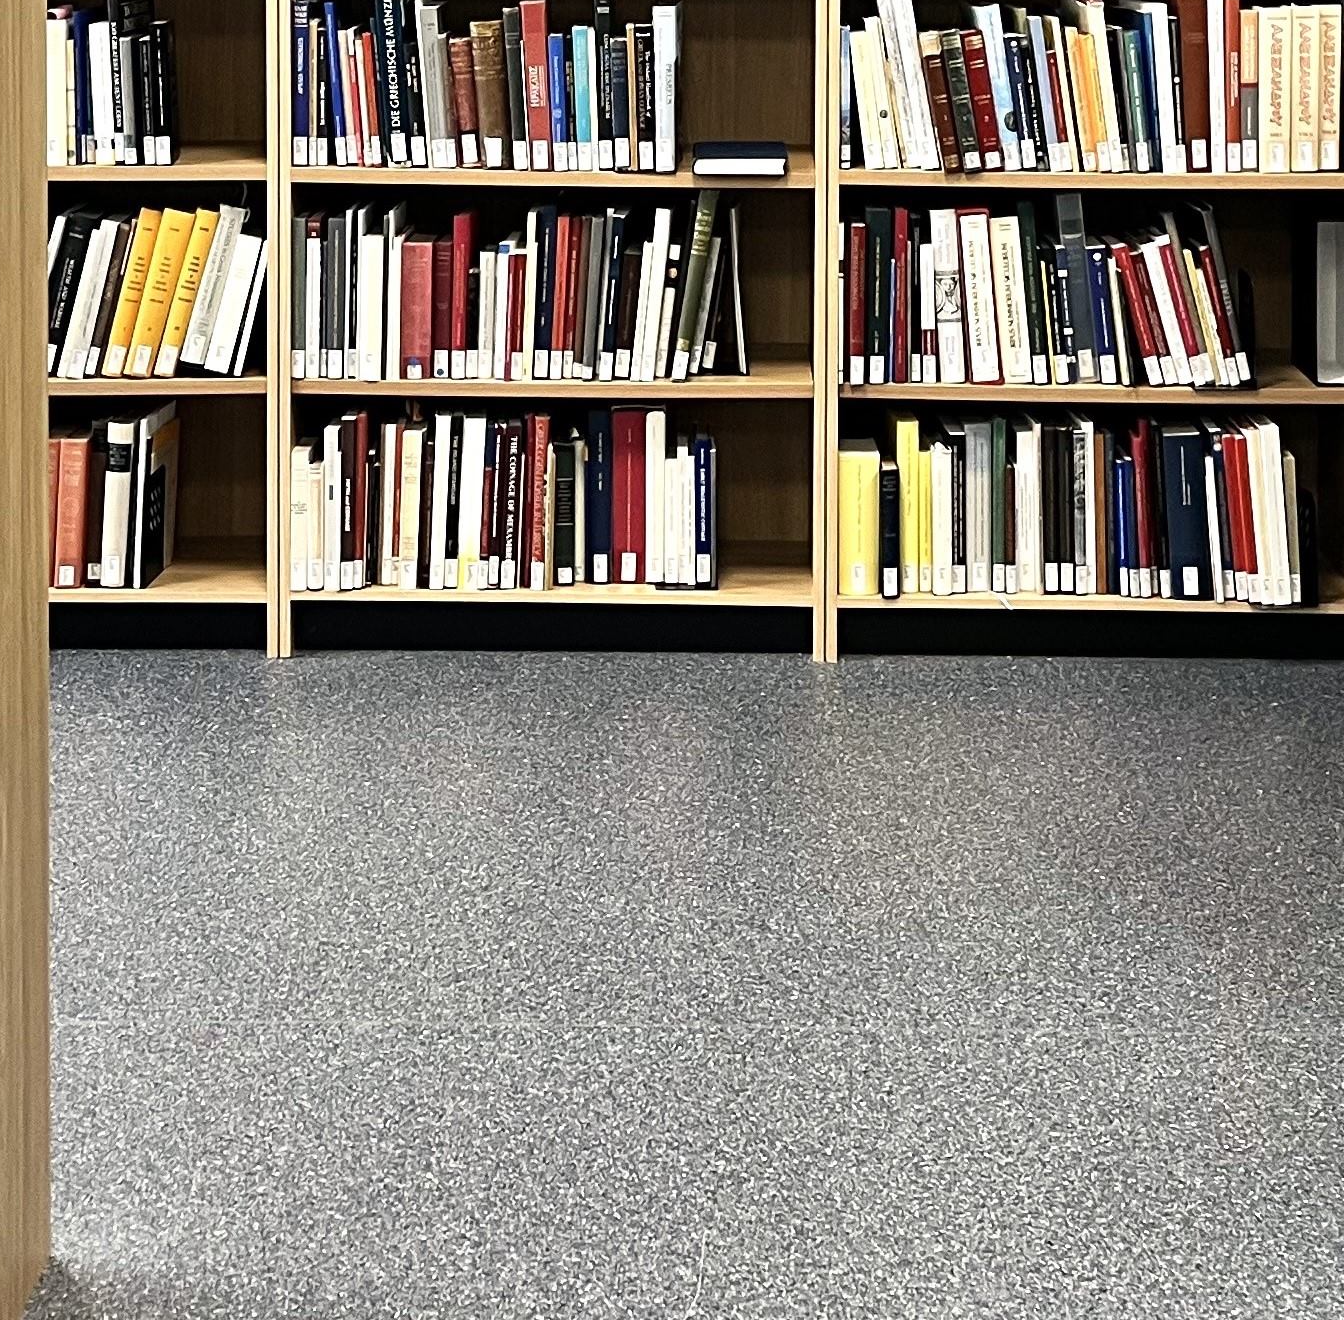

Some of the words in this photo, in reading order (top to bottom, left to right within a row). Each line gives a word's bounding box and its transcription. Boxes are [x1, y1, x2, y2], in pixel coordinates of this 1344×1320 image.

[386, 39, 400, 108] GRIECHISCHE
[391, 110, 400, 127] DIE
[509, 436, 518, 454] THE
[508, 456, 517, 497] COINAGE
[507, 500, 516, 510] OF
